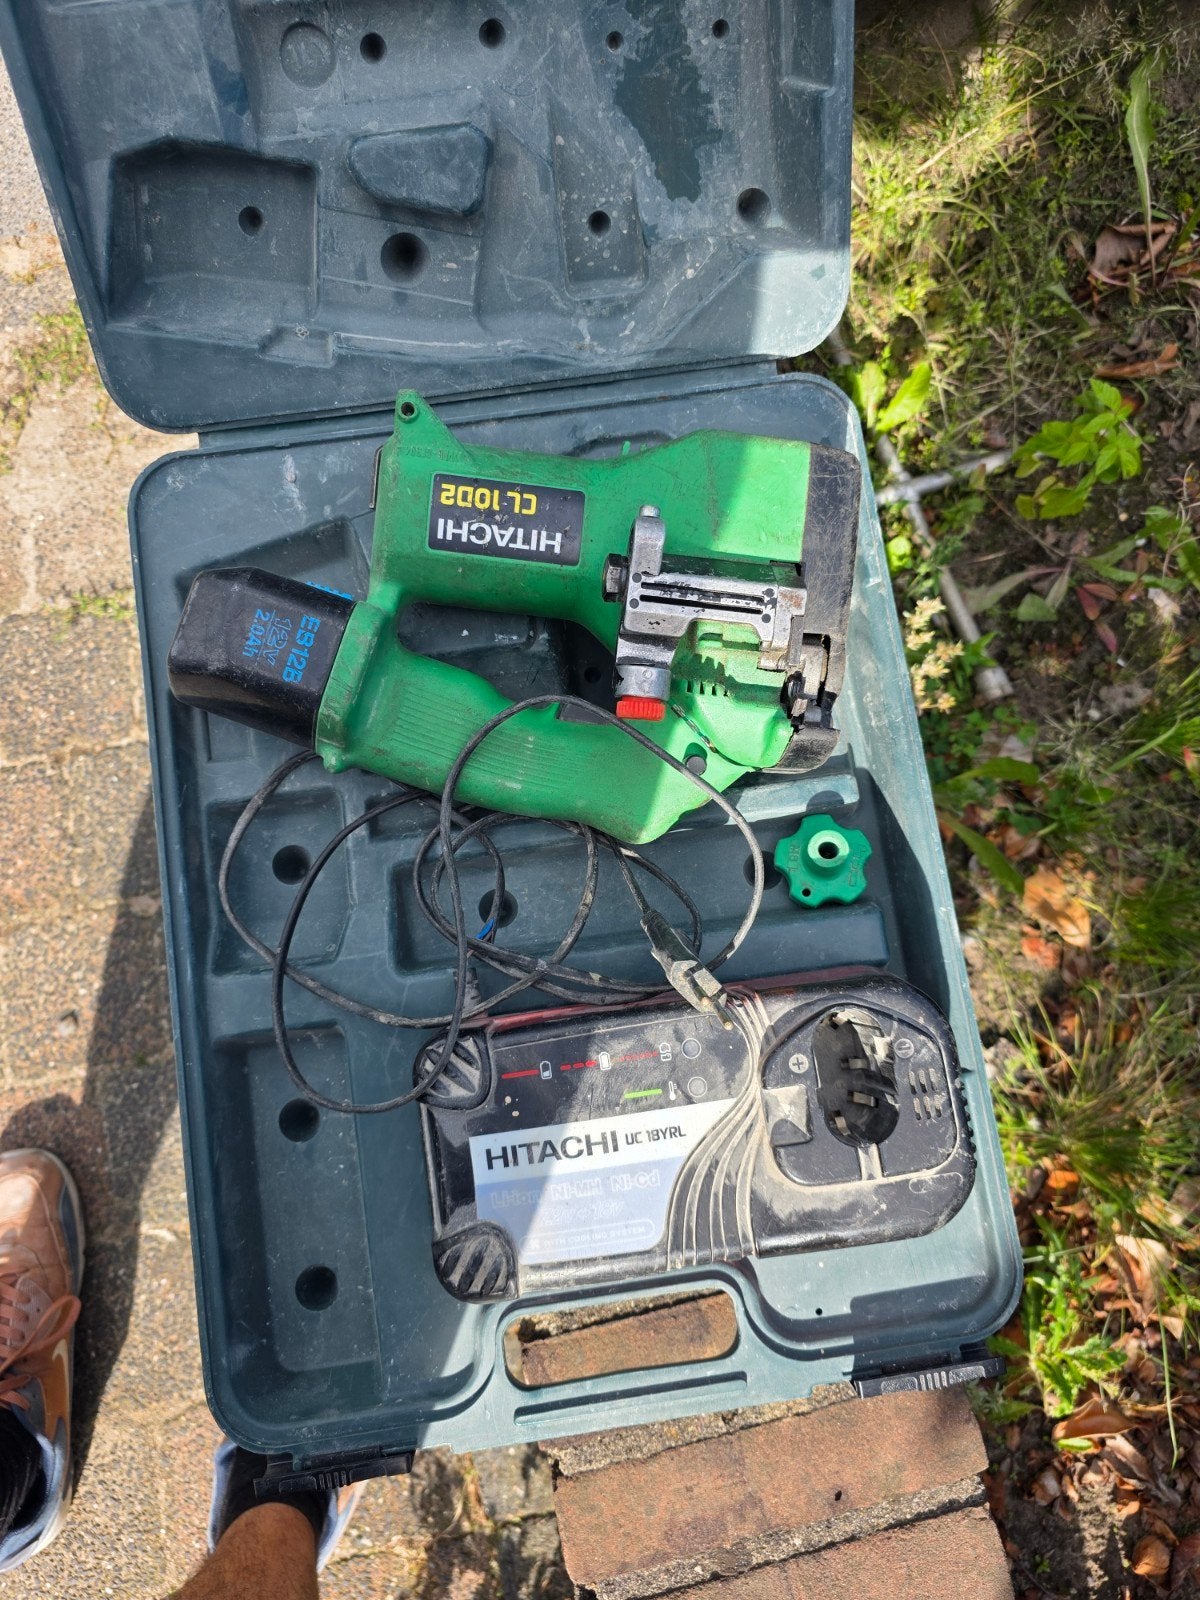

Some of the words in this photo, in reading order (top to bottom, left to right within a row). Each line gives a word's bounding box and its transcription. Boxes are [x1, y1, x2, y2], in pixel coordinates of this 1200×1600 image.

[440, 484, 500, 511] 10D2
[506, 491, 537, 515] CL
[437, 518, 562, 553] HITACHI
[242, 609, 270, 657] 2.0Ah
[486, 1130, 620, 1170] HITACHI
[625, 1131, 642, 1146] UC
[647, 1125, 686, 1144] 18YRL
[611, 1169, 660, 1192] Ni-Cd
